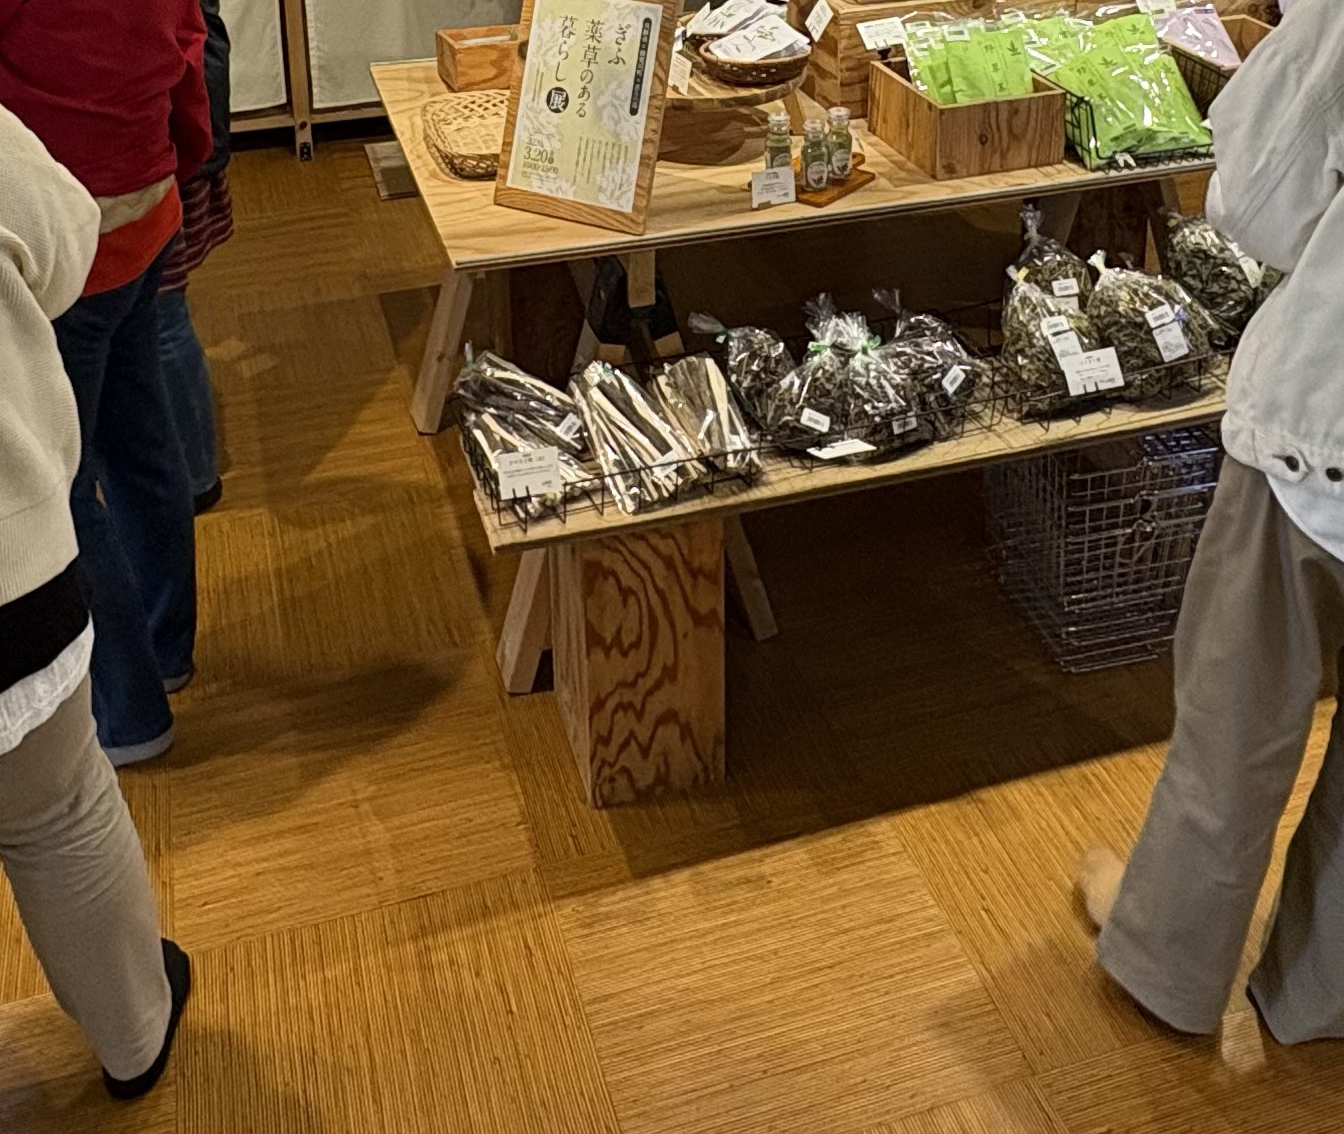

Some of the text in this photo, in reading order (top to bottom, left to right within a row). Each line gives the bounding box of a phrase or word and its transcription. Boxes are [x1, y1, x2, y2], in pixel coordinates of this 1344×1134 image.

[554, 14, 579, 82] 暮らし
[575, 18, 605, 118] 薬草のある
[608, 23, 631, 66] ぎふ
[547, 88, 568, 113] 展
